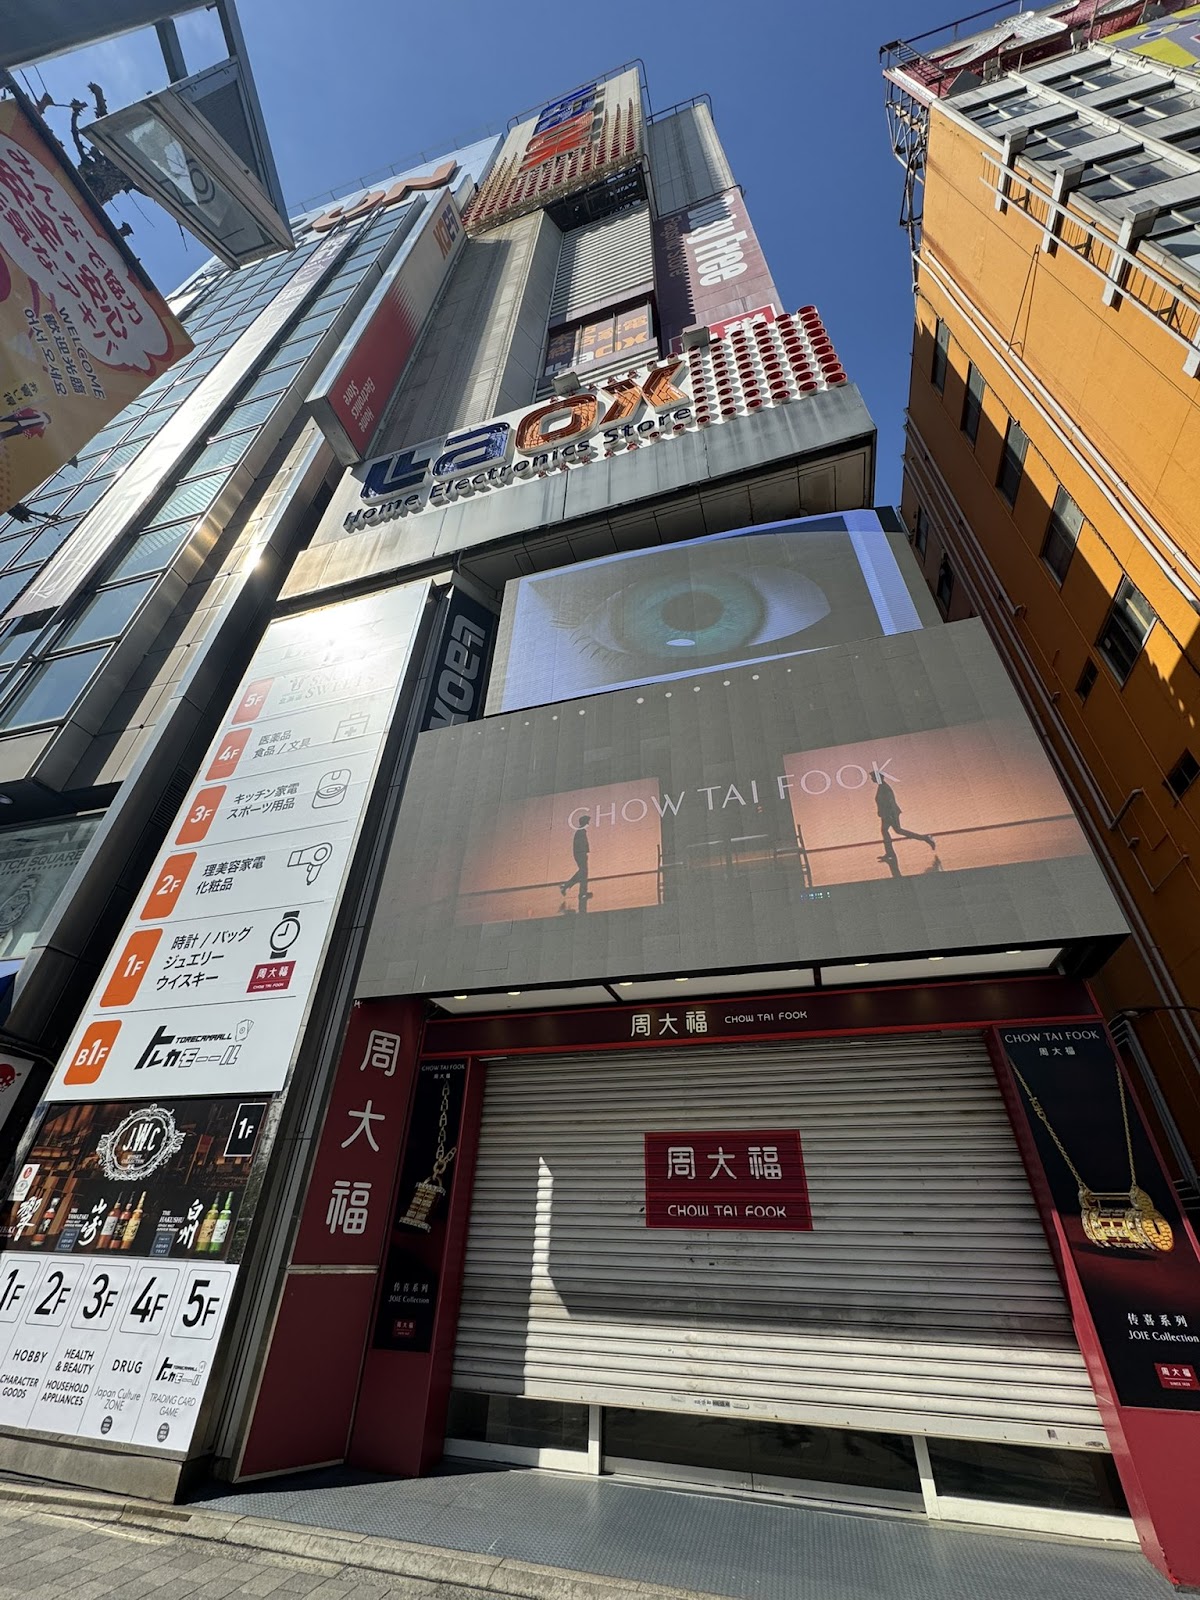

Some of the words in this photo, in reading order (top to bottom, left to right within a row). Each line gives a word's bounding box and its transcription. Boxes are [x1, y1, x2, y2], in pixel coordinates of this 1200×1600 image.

[7, 149, 144, 325] みんなで協力
[0, 158, 128, 340] 安全・安心
[693, 230, 748, 287] Free
[667, 246, 686, 278] Store
[25, 308, 48, 342] 어서
[42, 346, 67, 395] 오세요
[59, 307, 105, 399] WELCOME
[343, 380, 359, 405] Store
[351, 377, 376, 420] Electronics
[359, 406, 374, 432] Home
[342, 493, 420, 527] Home
[429, 438, 591, 501] Electronics
[603, 406, 692, 444] Store
[244, 693, 263, 708] 5F
[258, 730, 292, 746] 医薬品
[218, 748, 240, 762] 4F
[252, 744, 275, 760] 食品
[288, 737, 311, 752] 文具
[233, 783, 300, 805] キッチン家電
[567, 791, 686, 831] CHOW
[697, 781, 760, 811] TAI
[776, 758, 901, 800] FOOK
[190, 808, 213, 824] 3F
[226, 797, 296, 820] スポーツ用品
[29, 849, 85, 867] SQUARE
[203, 855, 265, 878] 理美容家電
[156, 874, 181, 896] 2F
[196, 877, 233, 896] 化粧品
[171, 934, 198, 951] 時計
[213, 926, 254, 945] バッグ
[123, 953, 145, 978] 1F
[163, 952, 225, 970] ジュエリー
[156, 972, 219, 991] ウイスキー
[256, 965, 289, 980] 周大福
[630, 1010, 708, 1037] 周大福
[724, 1014, 754, 1024] CHOW
[757, 1013, 774, 1022] TAI
[778, 1011, 808, 1021] FOOK
[1004, 1033, 1040, 1043] CHOW
[1043, 1032, 1063, 1041] TAI
[1065, 1030, 1099, 1040] FOOK
[74, 1038, 108, 1067] B1F
[1038, 1046, 1076, 1056] 周大福
[238, 1117, 254, 1140] 1F
[326, 1029, 401, 1235] 周大福
[667, 1146, 783, 1180] 周大福
[667, 1204, 709, 1217] CHOW
[714, 1205, 738, 1217] TAI
[745, 1205, 787, 1218] FOOK
[0, 1269, 25, 1311] 1F
[34, 1271, 71, 1316] 2F
[82, 1273, 119, 1319] 3F
[388, 1295, 401, 1303] JOIE
[402, 1295, 430, 1304] Collection
[130, 1277, 168, 1323] 4F
[182, 1279, 220, 1327] 5F
[1127, 1313, 1188, 1328] 传喜系列
[1128, 1330, 1150, 1340] JOIE
[1152, 1331, 1200, 1343] Collection
[12, 1349, 48, 1363] HOBBY
[64, 1348, 95, 1361] HEALTH
[55, 1361, 62, 1371] &
[62, 1362, 94, 1375] BEAUTY
[111, 1359, 143, 1374] DRUG
[1160, 1367, 1192, 1378] 周大福
[0, 1374, 39, 1387] CHARACTER
[45, 1380, 89, 1393] HOUSEHOLD
[2, 1387, 27, 1399] GOODS
[41, 1392, 84, 1406] APPLIANCES
[94, 1386, 117, 1399] Japan
[117, 1388, 141, 1401] Culture
[150, 1393, 177, 1405] TRADING
[177, 1395, 196, 1407] CARD
[104, 1400, 124, 1412] ZONE
[159, 1406, 180, 1418] GAME
